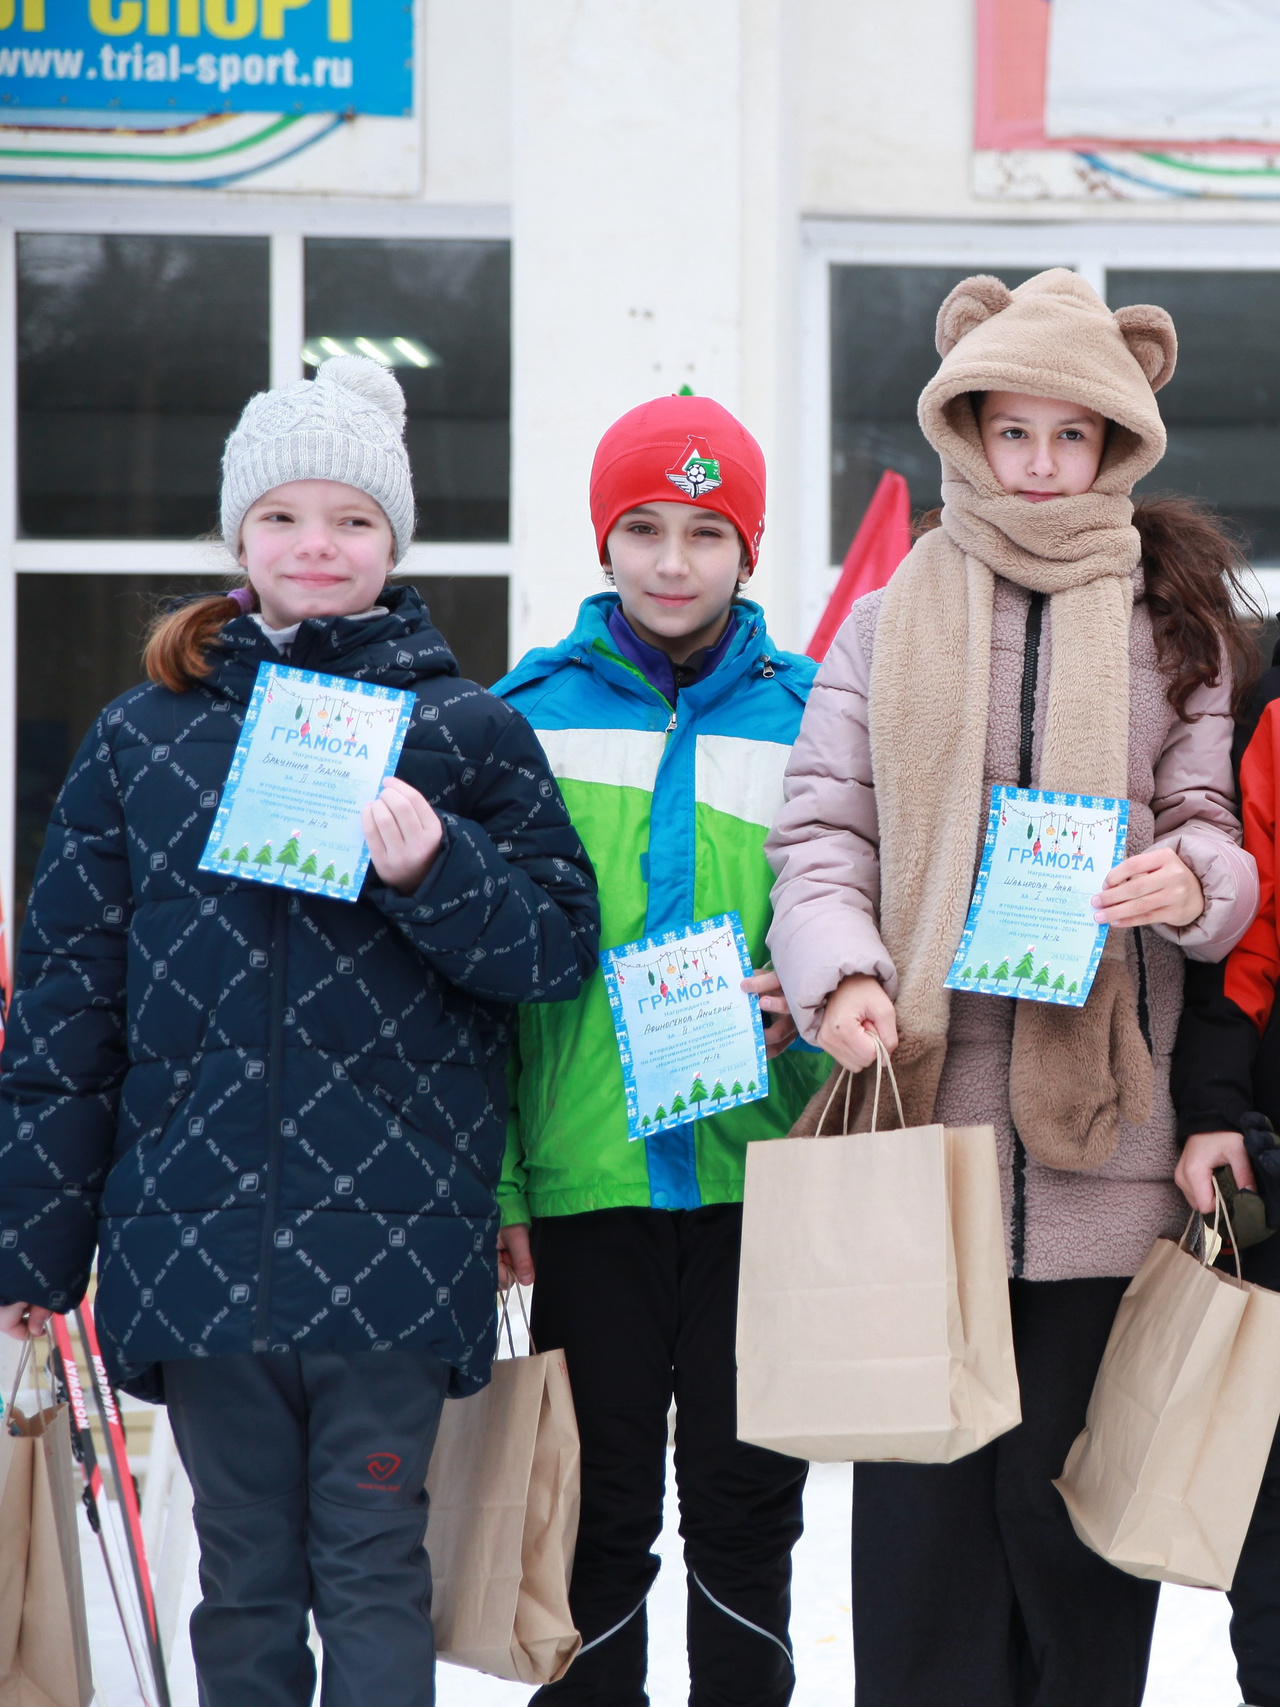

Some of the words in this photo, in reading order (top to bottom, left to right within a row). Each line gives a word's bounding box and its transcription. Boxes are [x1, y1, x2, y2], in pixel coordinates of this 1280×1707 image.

[0, 42, 353, 92] www.trial-sport.ru
[270, 725, 371, 760] ГРАМОТА
[170, 762, 184, 777] FILA
[185, 776, 199, 790] FILA
[183, 812, 198, 828] FILA
[168, 831, 182, 847] FILA
[1006, 847, 1096, 872] ГРАМОТА
[218, 916, 231, 931] FILA
[303, 916, 318, 933] FILA
[232, 930, 248, 947] FILA
[321, 934, 335, 951] FILA
[316, 974, 333, 990] FILA
[298, 991, 315, 1006] FILA
[638, 973, 728, 1014] ГРАМОТА
[299, 1139, 314, 1156] FILA
[296, 1250, 312, 1267] FILA
[372, 1250, 387, 1265] FILA
[408, 1250, 420, 1267] FILA
[214, 1266, 229, 1282] FILA
[315, 1266, 331, 1283] FILA
[355, 1267, 371, 1283] FILA
[423, 1267, 435, 1284] FILA
[311, 1308, 329, 1324] FILA
[63, 1358, 90, 1430] NORDWAY
[91, 1354, 119, 1425] NORDWAY
